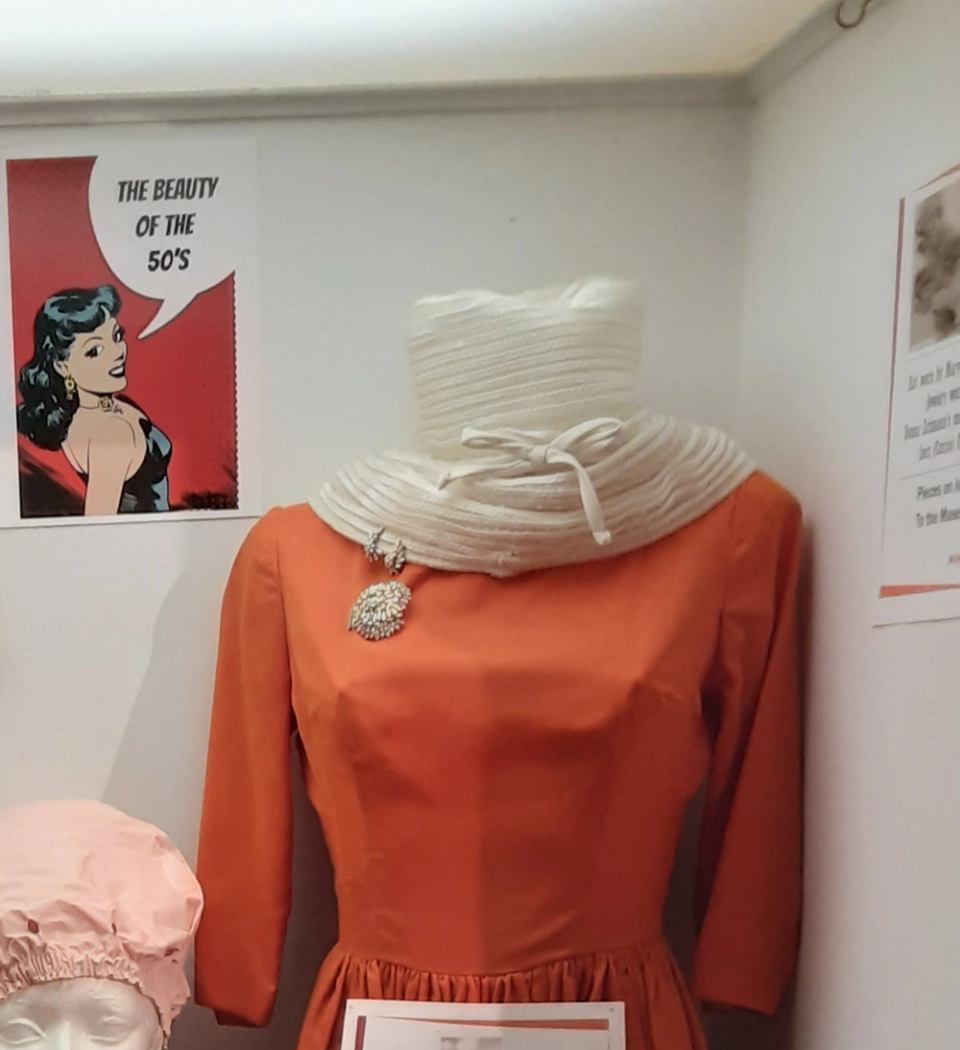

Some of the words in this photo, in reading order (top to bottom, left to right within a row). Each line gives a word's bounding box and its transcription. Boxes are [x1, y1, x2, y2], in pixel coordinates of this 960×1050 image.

[118, 180, 149, 202] THE
[153, 177, 219, 201] BEAUTY
[136, 215, 160, 237] OF
[165, 213, 196, 236] THE
[148, 248, 191, 272] 50'S
